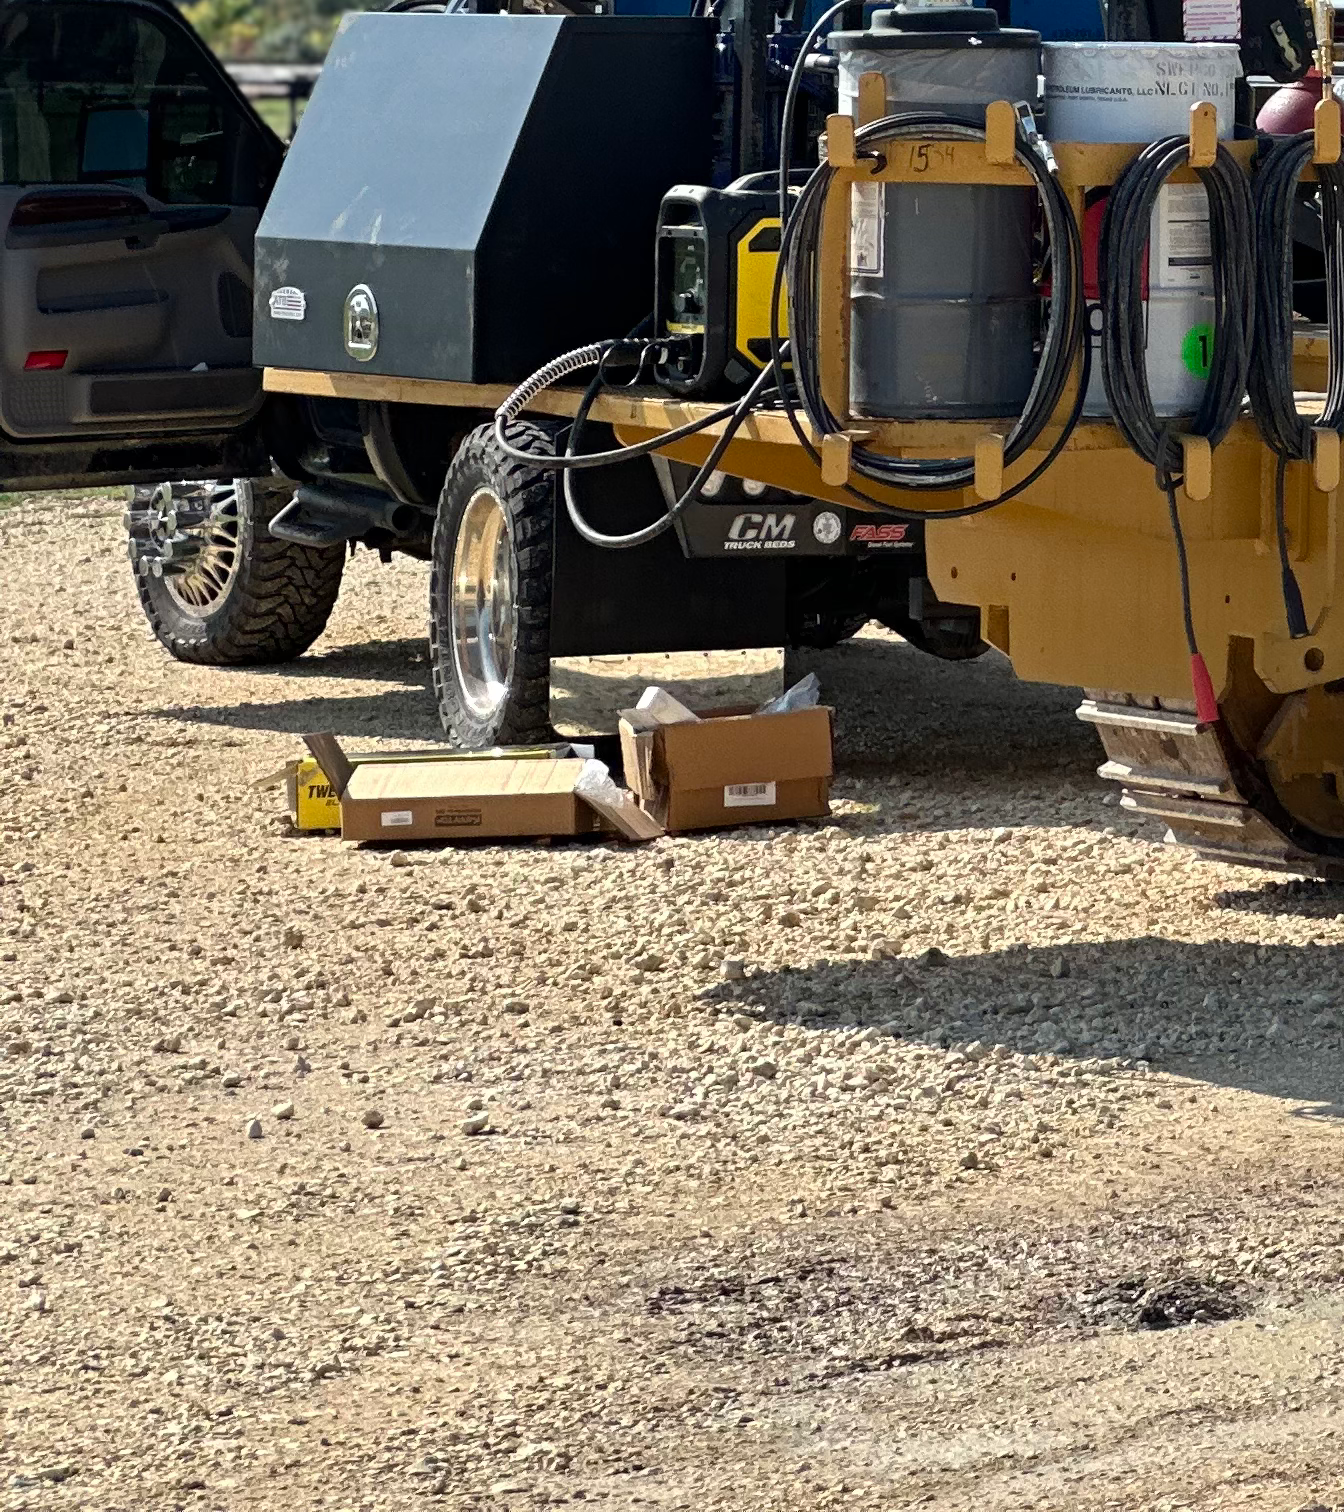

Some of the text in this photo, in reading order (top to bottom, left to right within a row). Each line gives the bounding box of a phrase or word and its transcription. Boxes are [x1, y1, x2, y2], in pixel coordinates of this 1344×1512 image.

[727, 513, 910, 541] CM FASS
[723, 540, 796, 550] TRUCK BEDS
